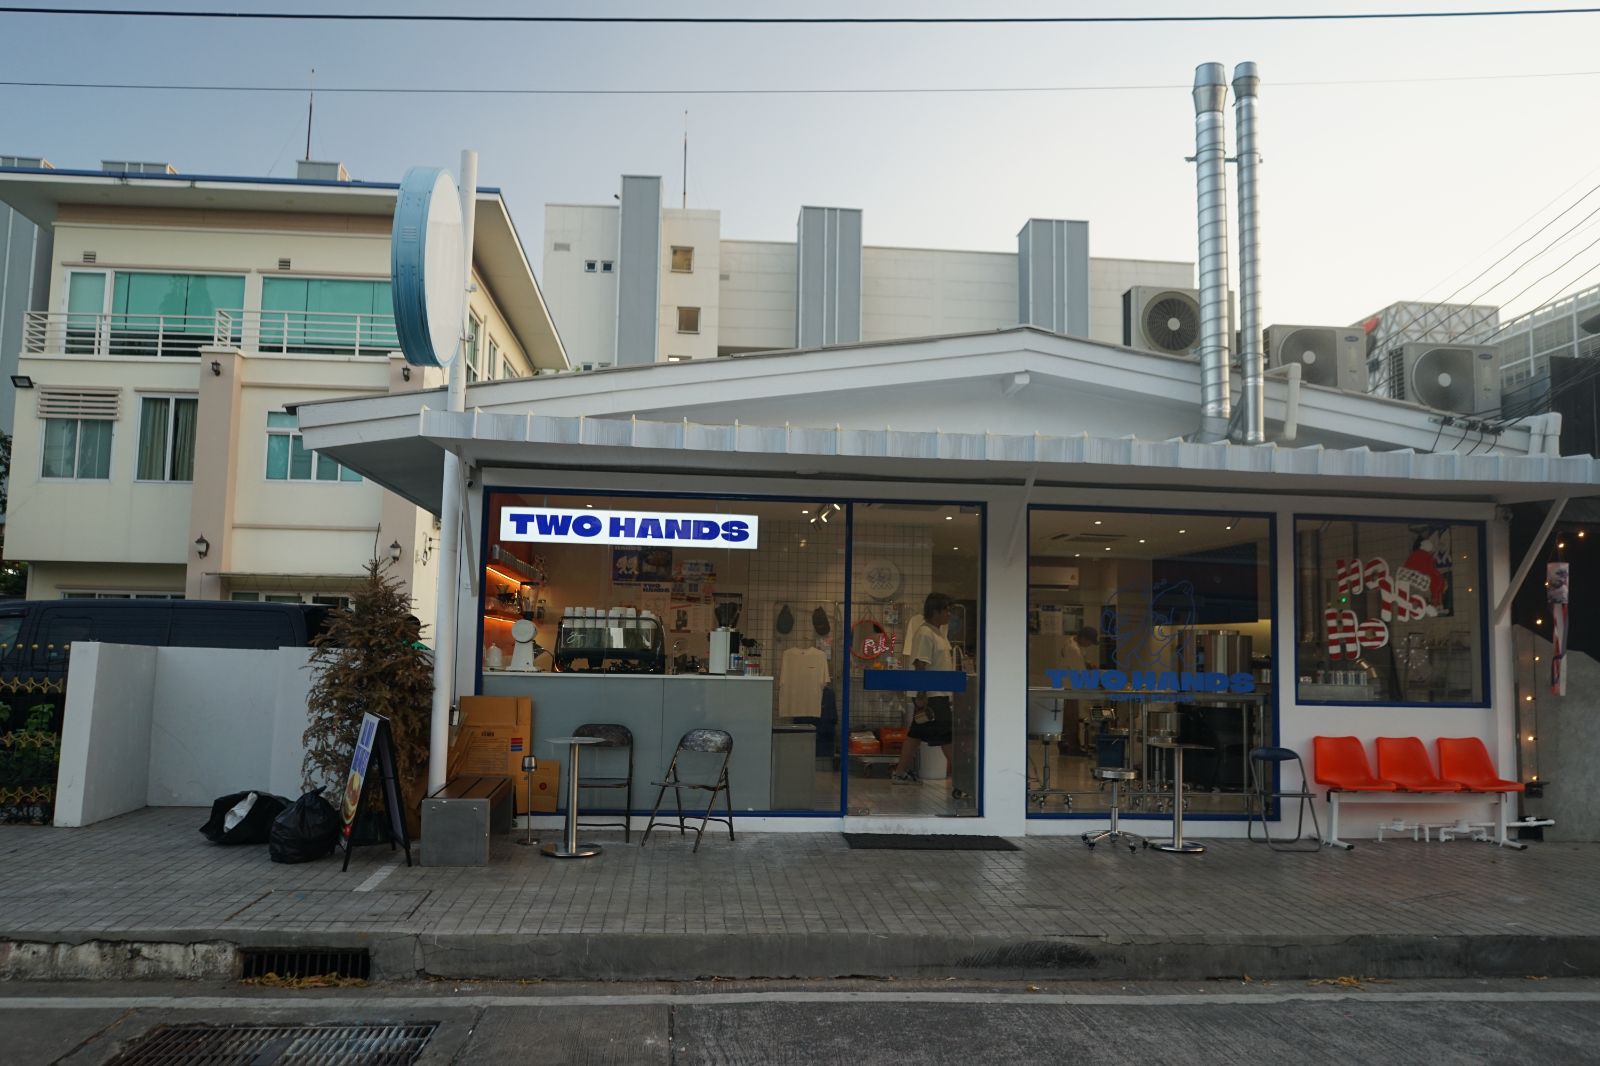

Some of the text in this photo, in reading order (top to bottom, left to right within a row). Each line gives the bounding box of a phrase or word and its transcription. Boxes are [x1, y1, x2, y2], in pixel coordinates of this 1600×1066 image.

[510, 513, 749, 542] TWO HANDS
[1045, 668, 1256, 693] TWO HANDS
